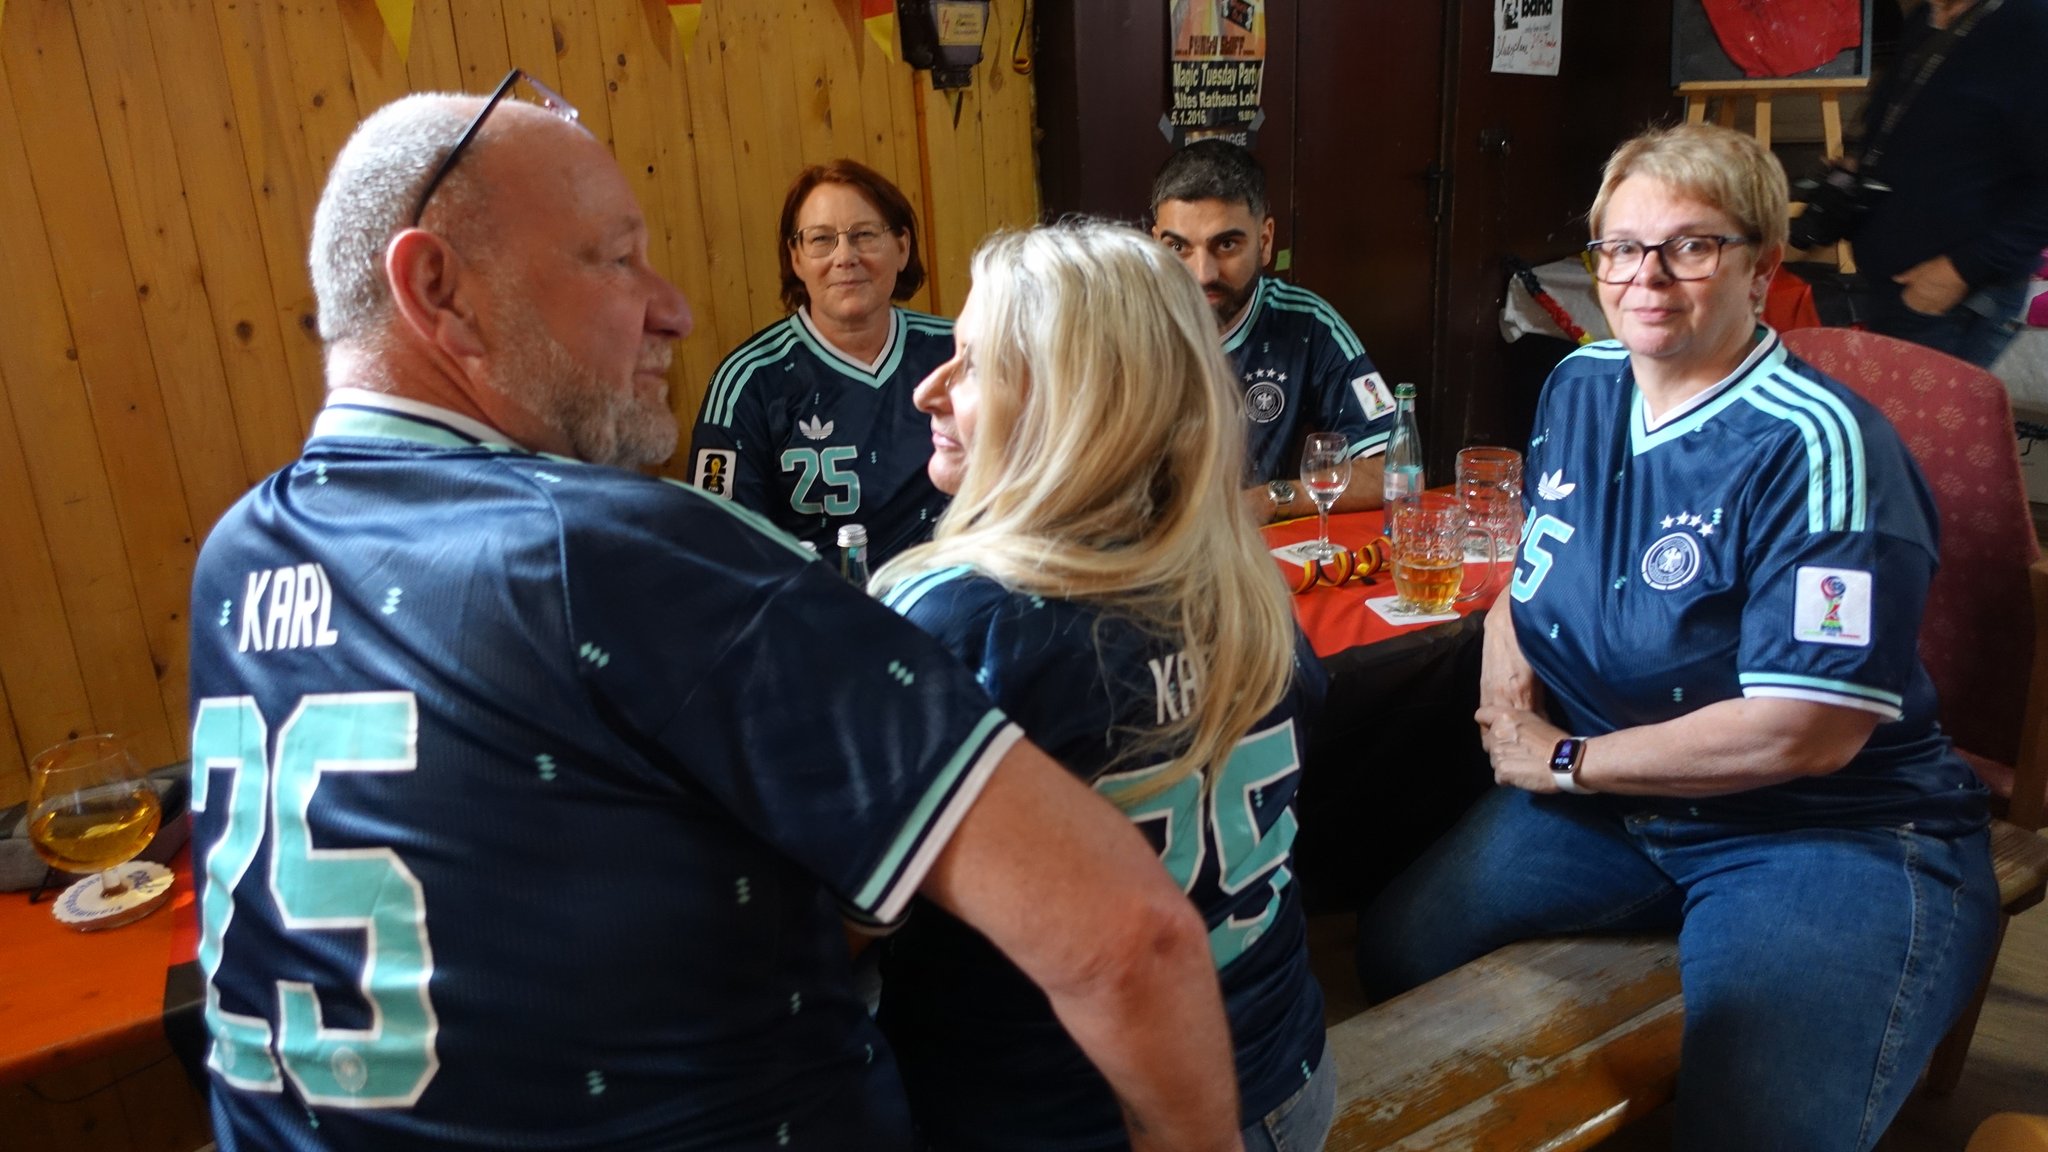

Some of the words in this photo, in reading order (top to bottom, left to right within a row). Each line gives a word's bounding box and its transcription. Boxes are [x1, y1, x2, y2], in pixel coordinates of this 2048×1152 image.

[1173, 62, 1199, 93] Magic
[1201, 62, 1237, 92] Tuesday
[1238, 62, 1258, 90] Party
[1173, 93, 1198, 109] Altes
[1199, 91, 1237, 108] Rathaus
[1239, 89, 1259, 106] Loh
[1171, 109, 1206, 126] 5.1.2016
[780, 446, 861, 516] 25
[239, 563, 338, 653] KARL
[1148, 652, 1206, 725] KA
[191, 690, 440, 1110] 25
